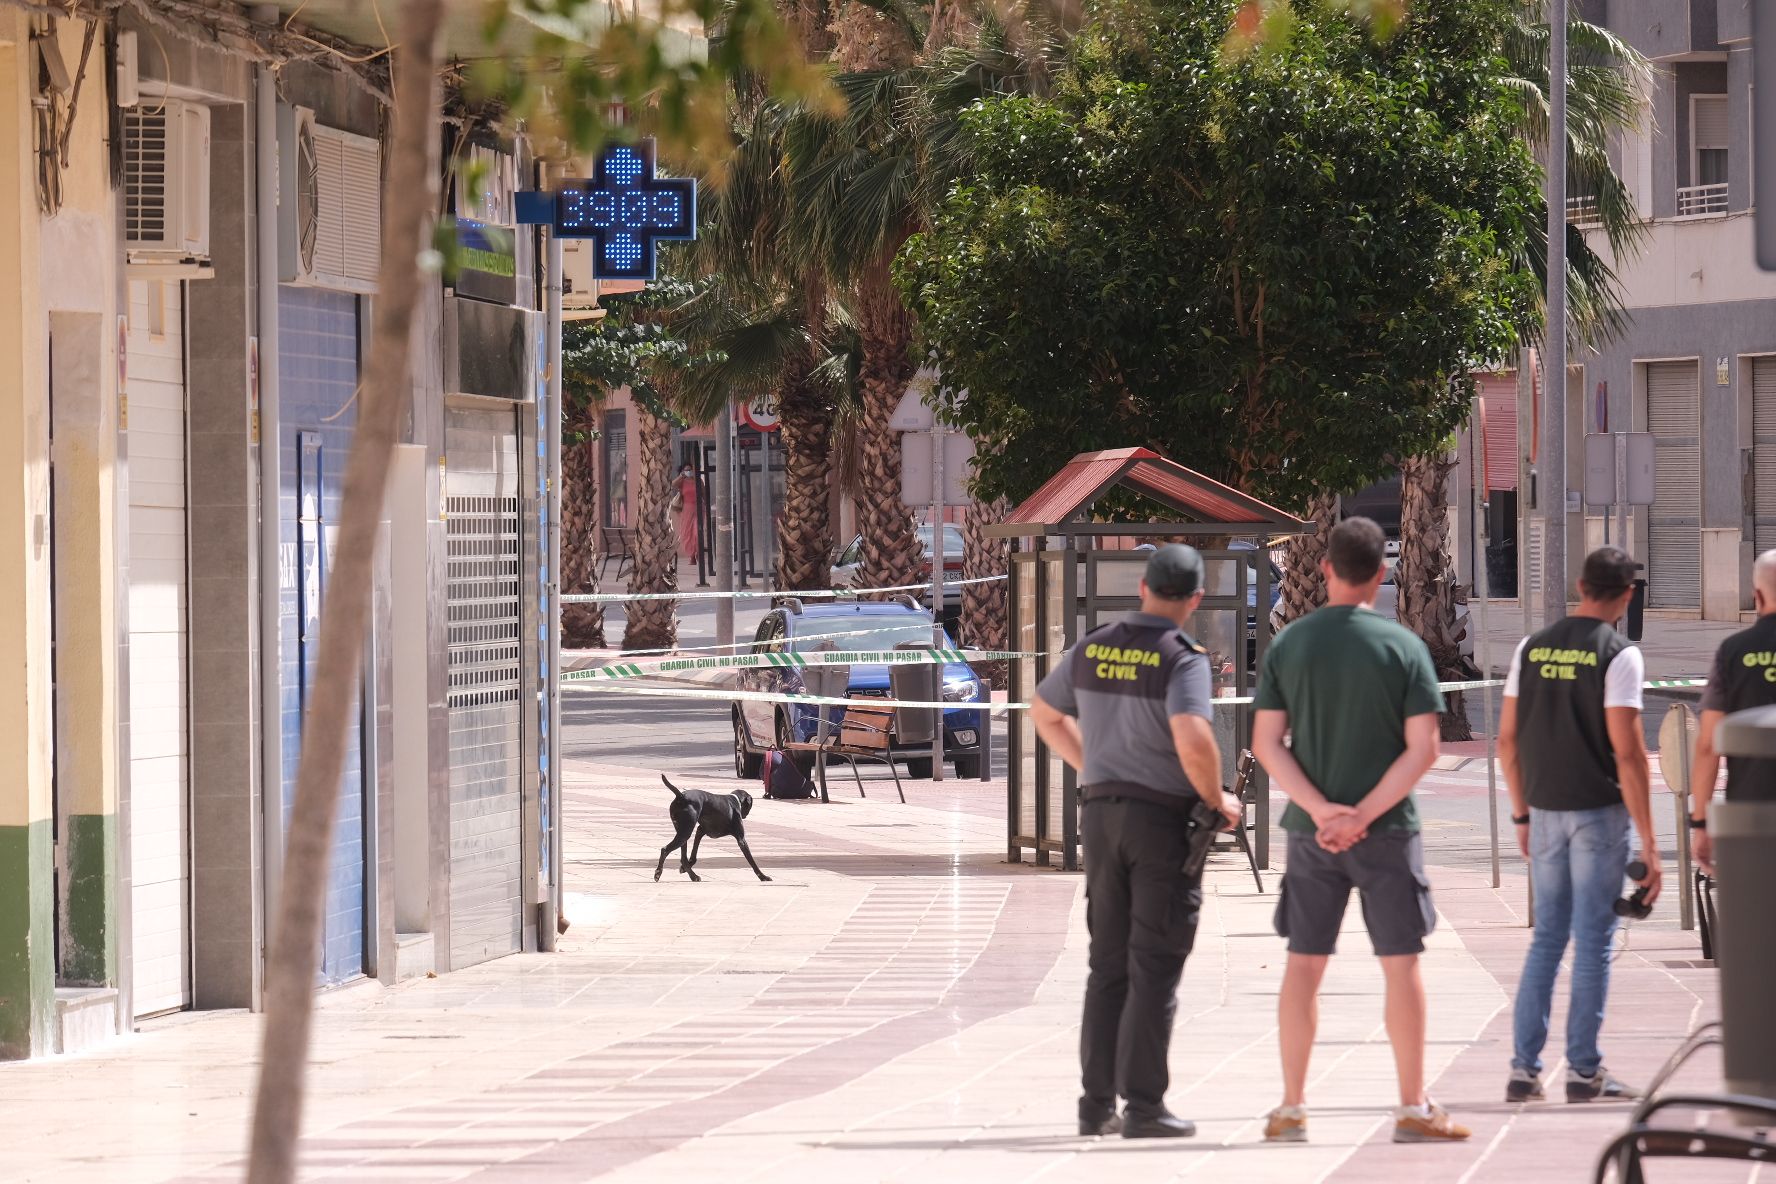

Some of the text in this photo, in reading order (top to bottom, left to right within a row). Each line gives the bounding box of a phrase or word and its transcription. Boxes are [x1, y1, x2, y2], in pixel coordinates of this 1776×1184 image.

[660, 656, 759, 671] GUARDIA CIVIL NO PASAR
[824, 652, 922, 663] GUARDIA CIVIL NO PASAR
[1085, 643, 1160, 667] GUARDIA
[1528, 647, 1597, 667] GUARDIA
[570, 670, 596, 679] PASAR
[1095, 662, 1138, 680] CIVIL
[1540, 663, 1577, 680] CIVIL
